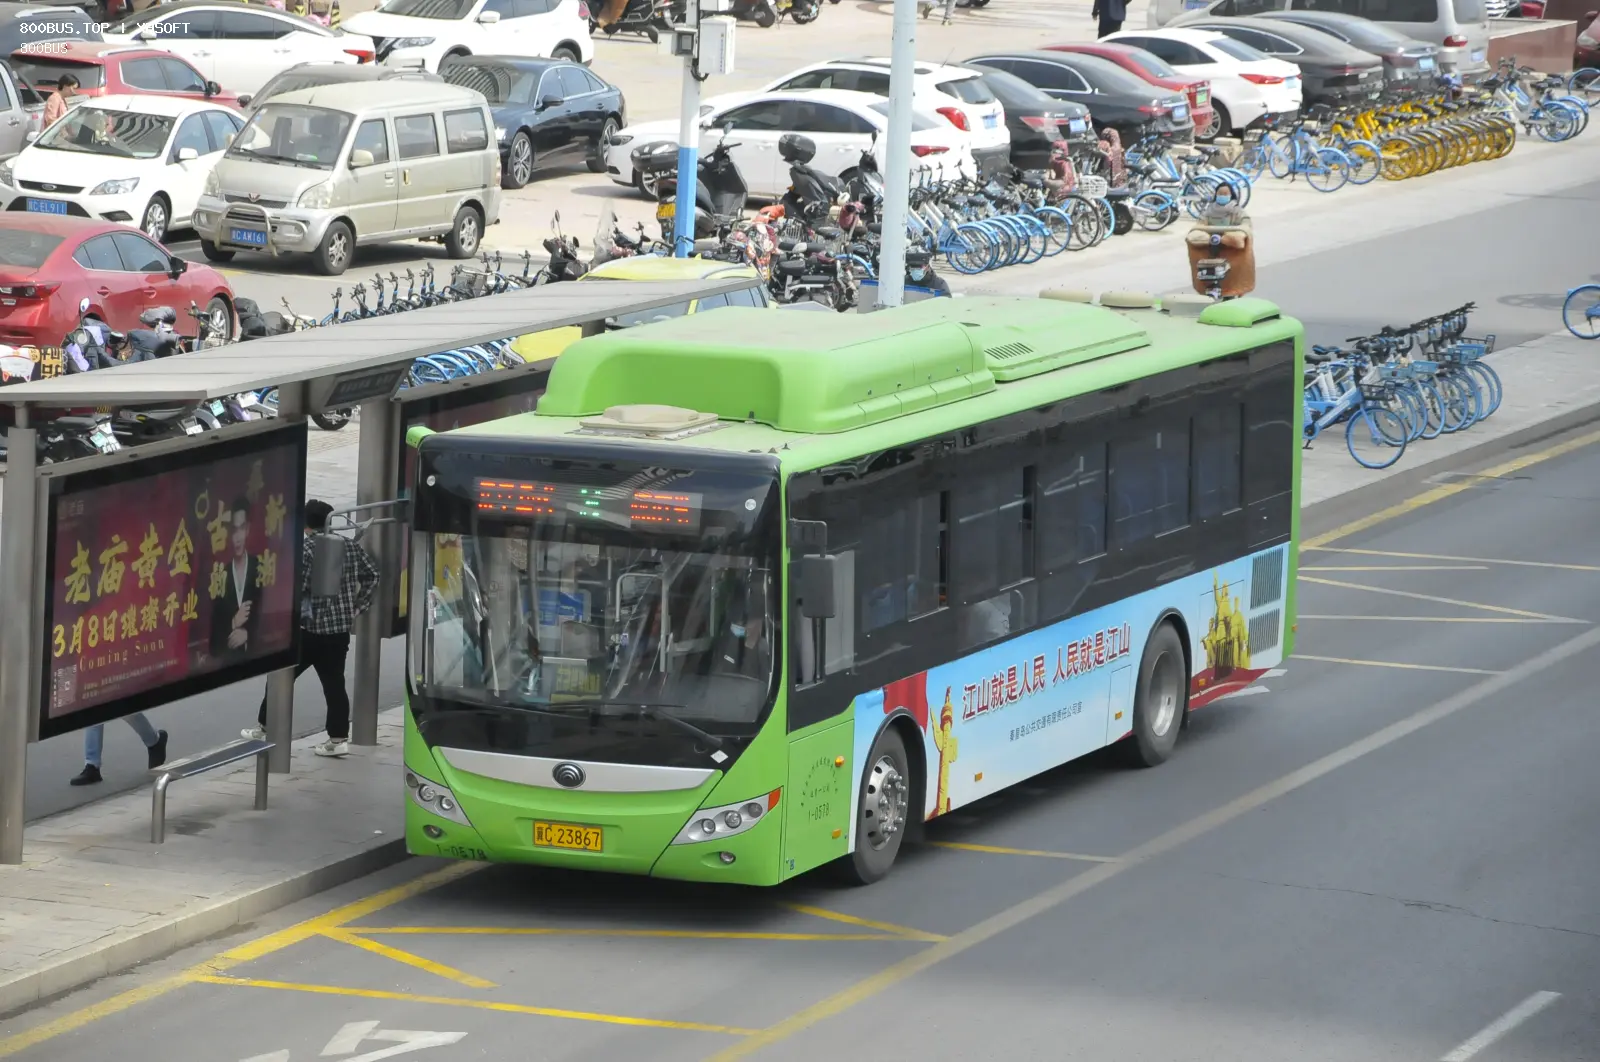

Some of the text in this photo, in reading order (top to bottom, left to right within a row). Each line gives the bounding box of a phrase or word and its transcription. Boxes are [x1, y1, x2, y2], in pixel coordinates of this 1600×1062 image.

[64, 517, 194, 604] 老庙黄金
[79, 650, 128, 672] Coming
[962, 622, 1131, 721] 江山就是人民 人民就是江山
